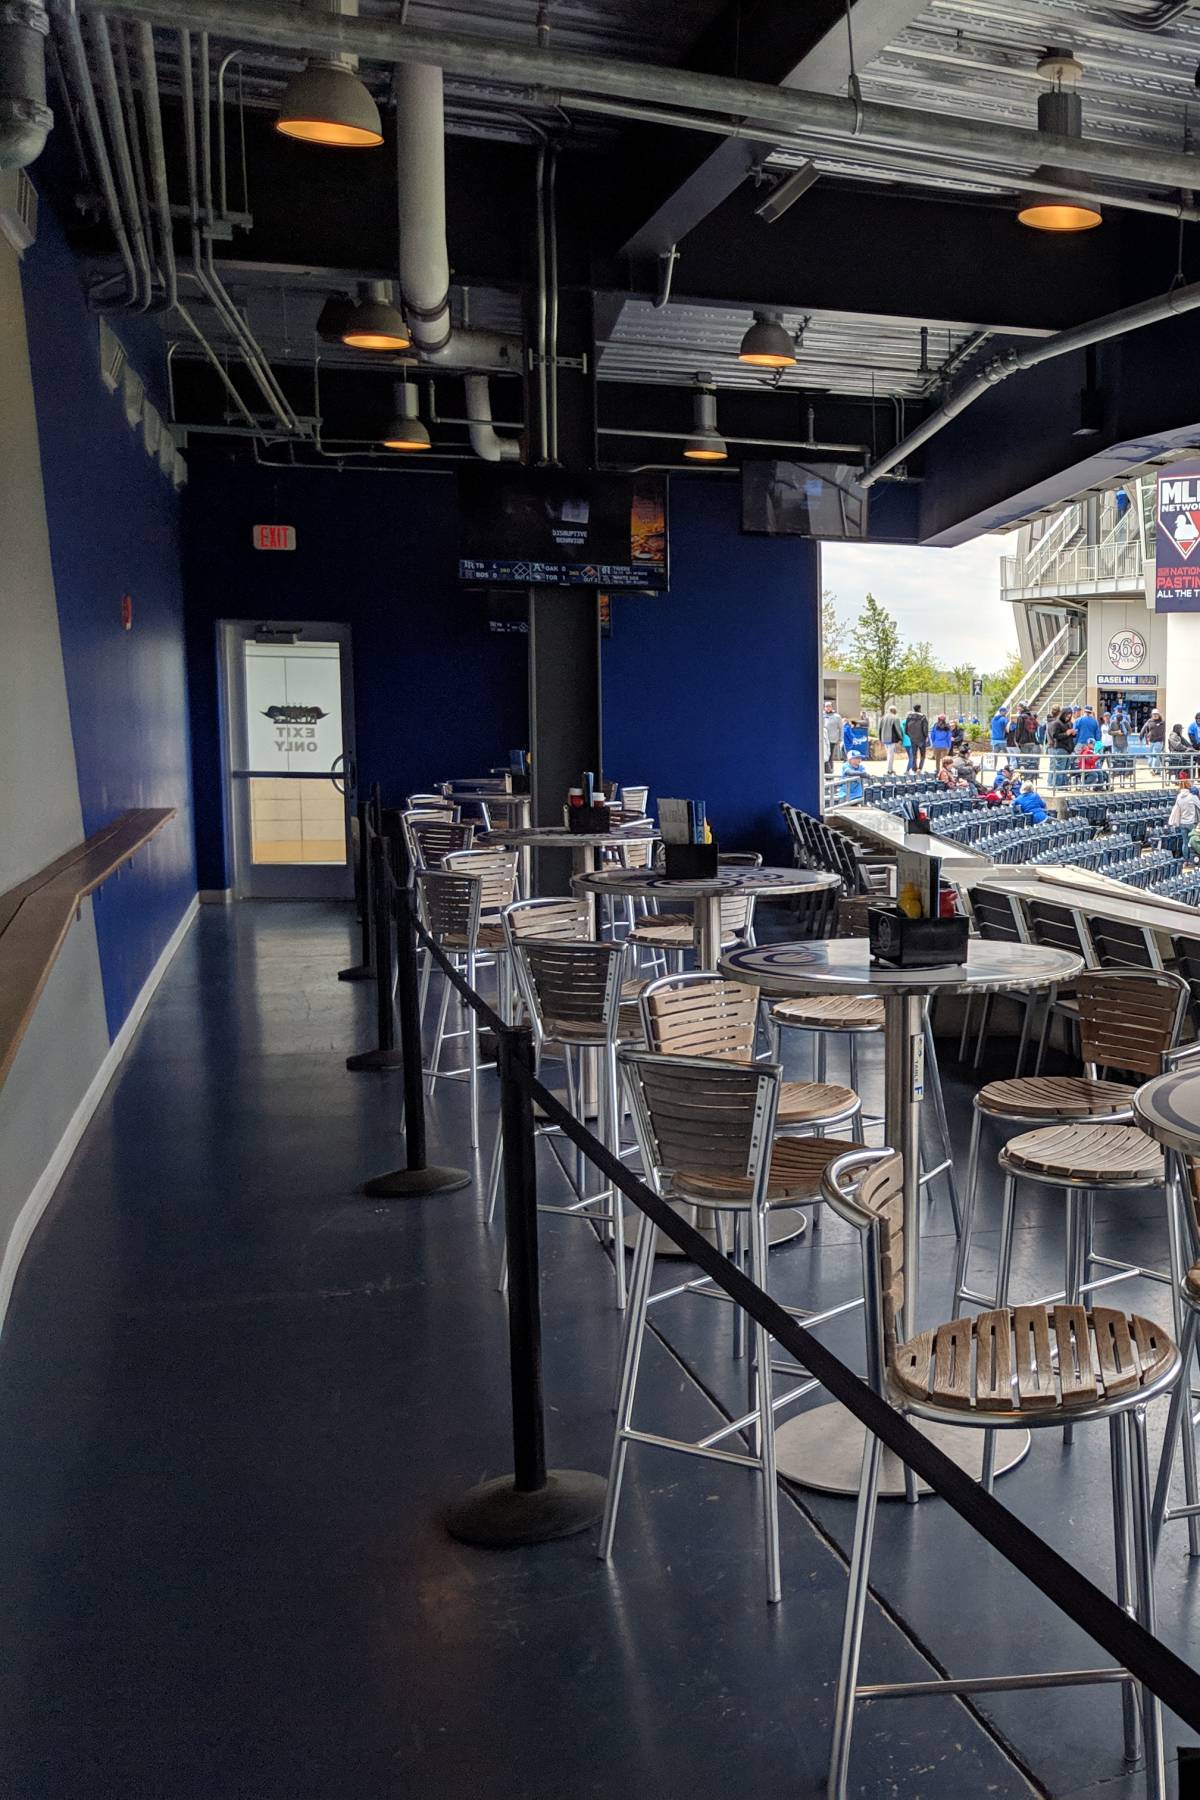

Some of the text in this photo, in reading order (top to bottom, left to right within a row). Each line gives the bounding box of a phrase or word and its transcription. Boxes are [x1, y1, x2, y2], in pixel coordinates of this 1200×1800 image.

[260, 527, 289, 548] EXIT
[1157, 590, 1173, 598] ALL
[1175, 589, 1192, 598] THE
[1109, 638, 1144, 662] 360
[1098, 676, 1136, 684] BASELINE
